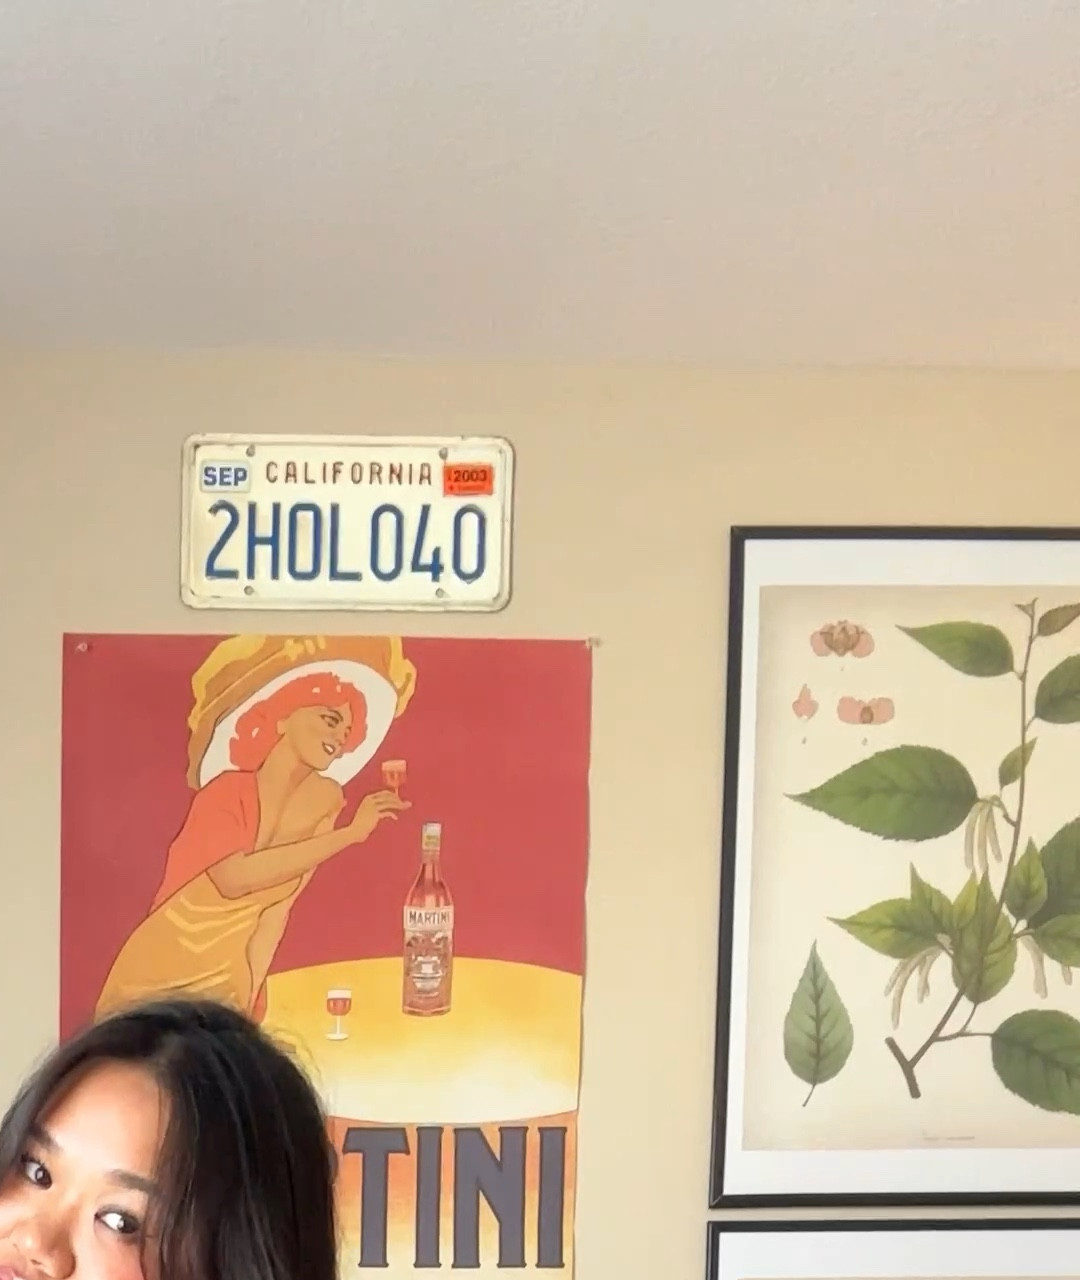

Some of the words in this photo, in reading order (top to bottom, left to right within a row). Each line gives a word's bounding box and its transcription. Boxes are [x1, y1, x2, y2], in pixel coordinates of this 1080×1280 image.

[203, 466, 248, 487] SEP
[265, 461, 433, 485] CALIFORNIA
[453, 469, 488, 483] 2003
[408, 911, 451, 925] MARTINI
